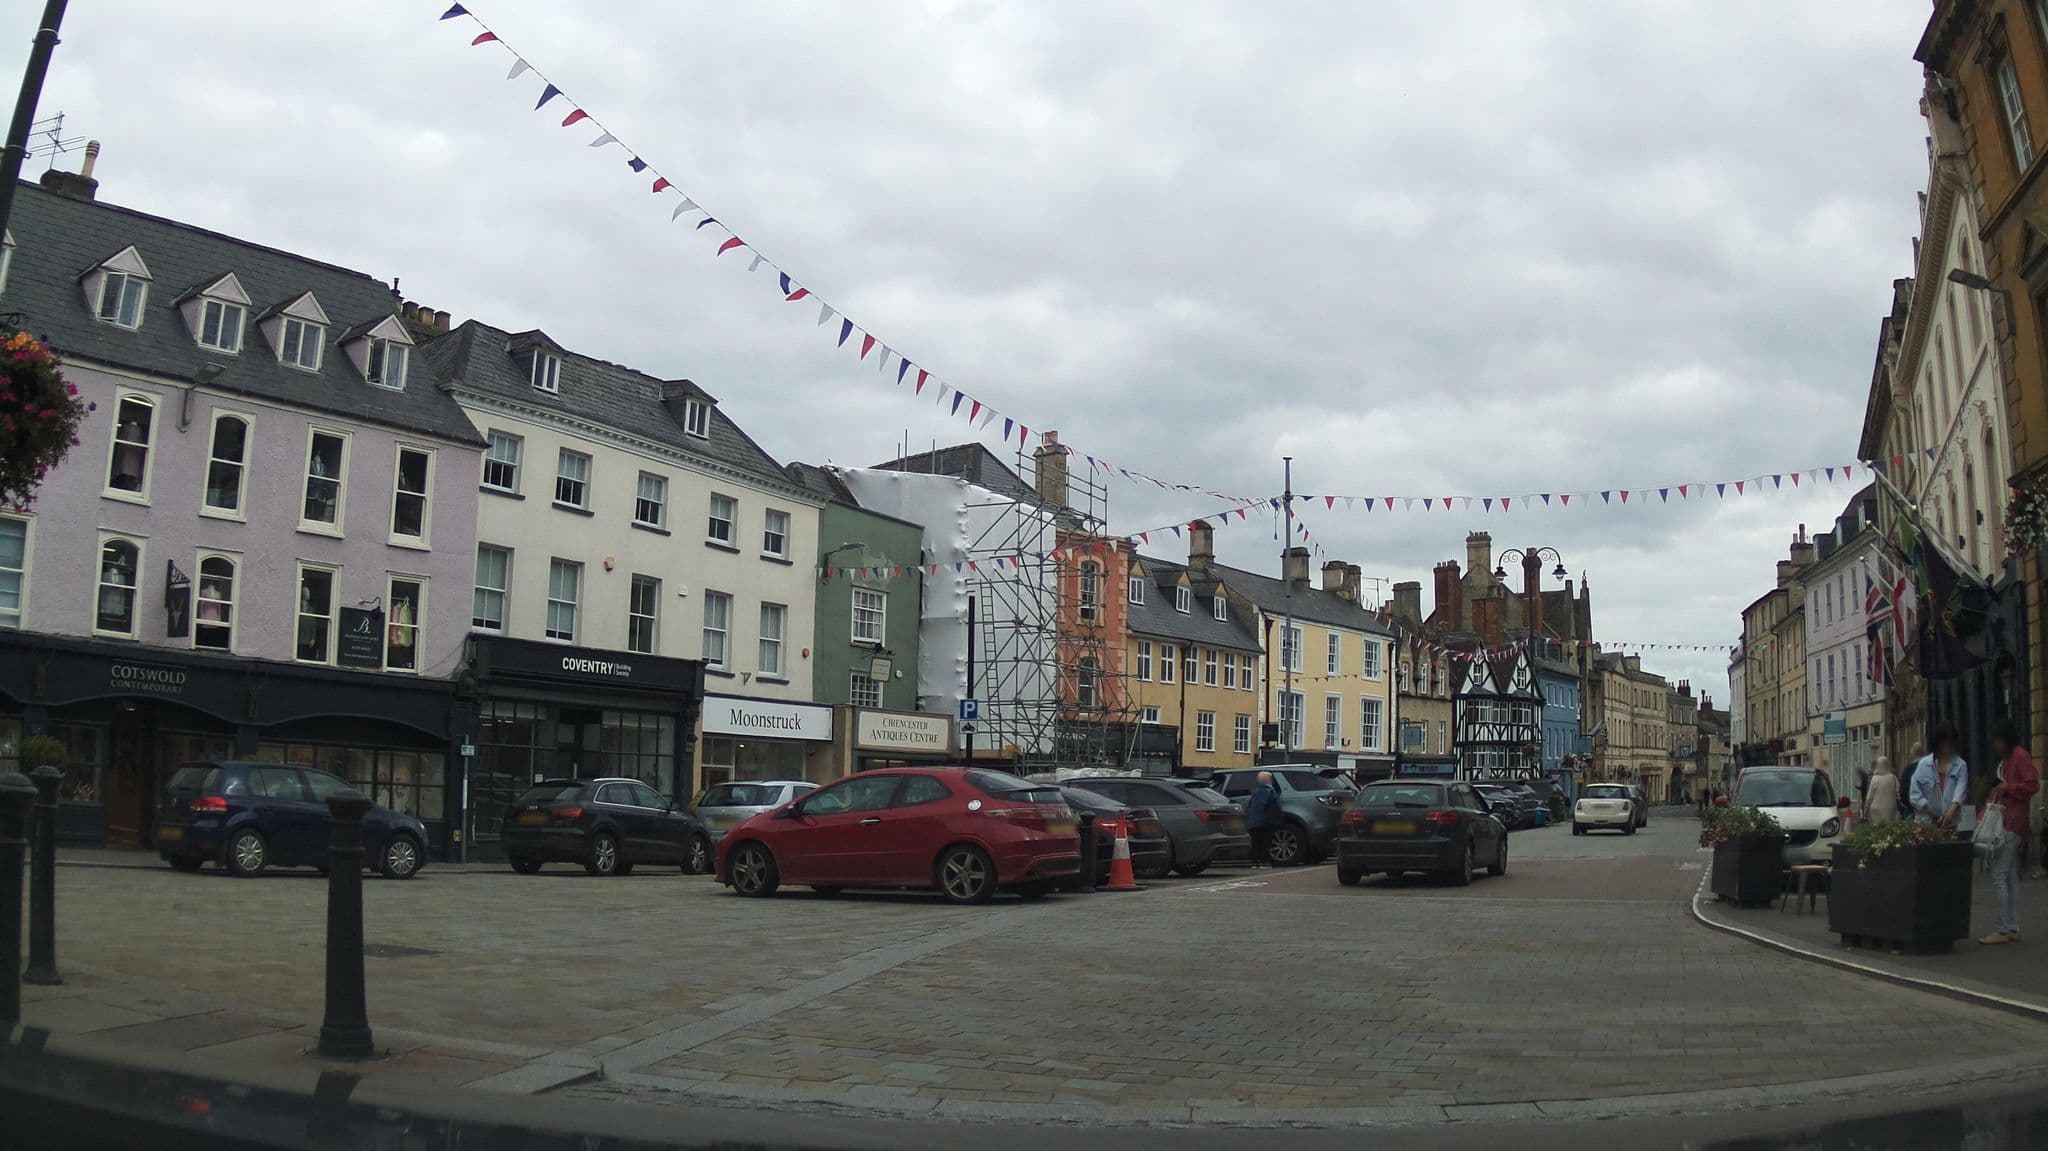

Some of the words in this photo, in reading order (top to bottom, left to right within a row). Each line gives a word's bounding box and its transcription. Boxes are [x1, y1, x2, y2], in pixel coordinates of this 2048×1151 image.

[111, 664, 186, 685] COTSWOLD
[562, 657, 614, 675] COVENTRY
[963, 701, 976, 718] P
[729, 708, 802, 731] Moonstruck
[882, 717, 929, 730] CIRENCESTER
[870, 728, 908, 741] ANTIQUES
[909, 731, 939, 744] CENTRE
